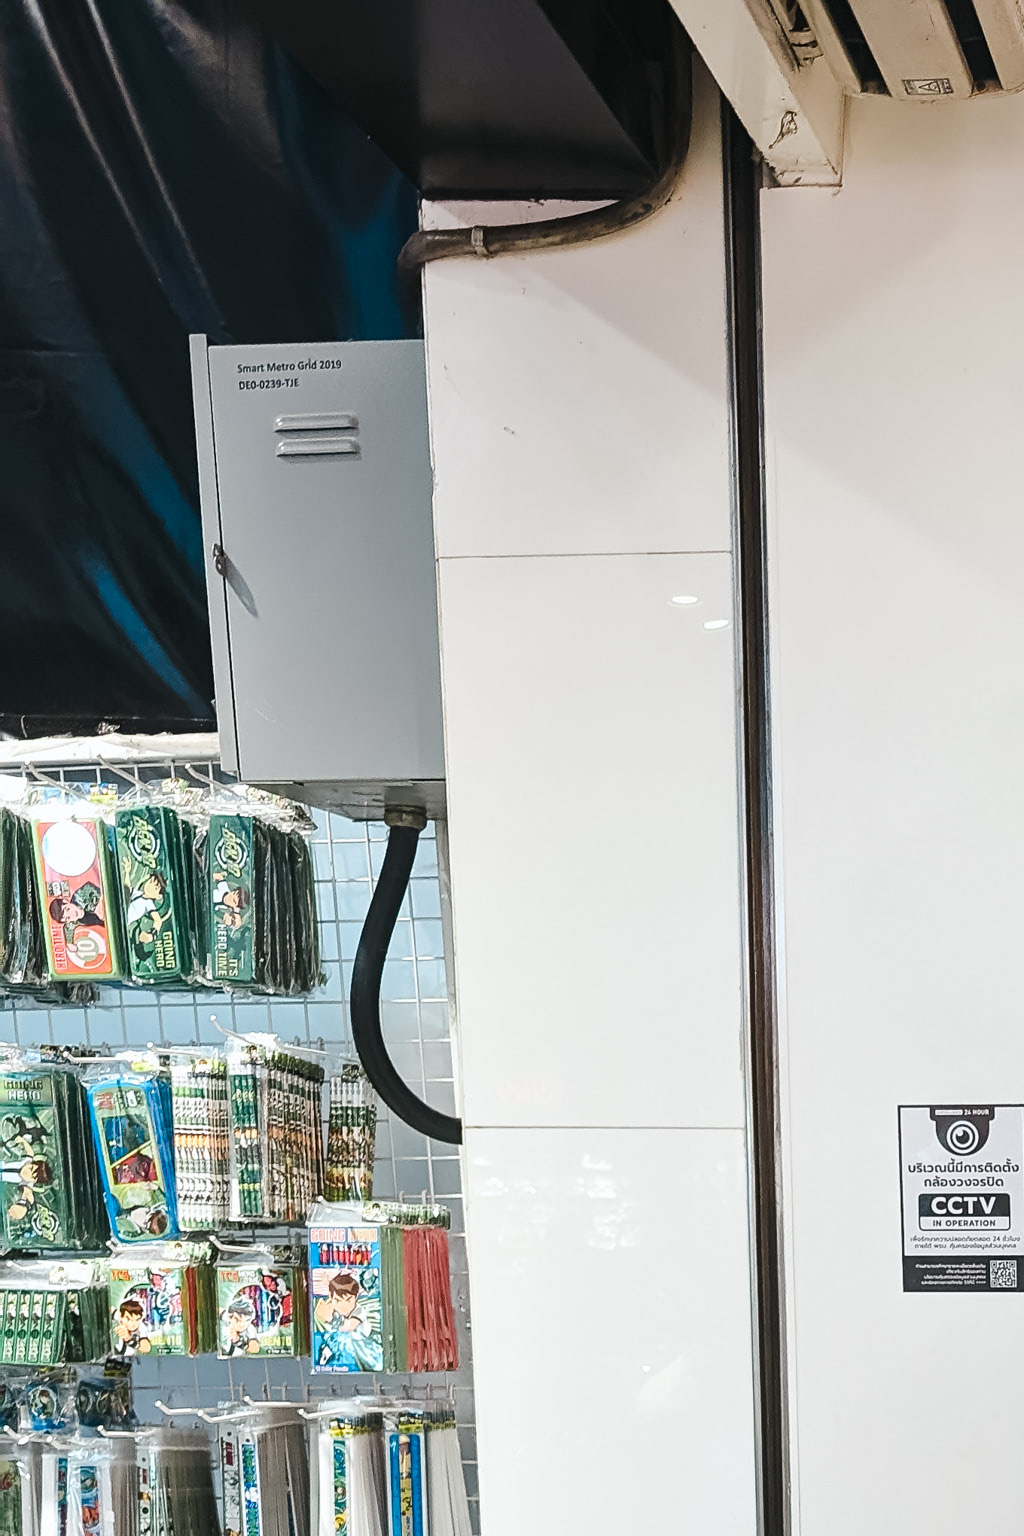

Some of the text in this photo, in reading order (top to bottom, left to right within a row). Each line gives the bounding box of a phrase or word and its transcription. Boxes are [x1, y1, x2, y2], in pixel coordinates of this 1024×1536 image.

[237, 359, 342, 373] Smart Metro Grid 2019
[154, 940, 165, 968] HERO
[163, 931, 176, 969] GOING
[217, 924, 228, 977] HERO TIME
[4, 1080, 44, 1091] GOING
[8, 1091, 41, 1101] HERO
[908, 1158, 1019, 1173] บริเวณนี้มีการติดตั้ง
[924, 1176, 1004, 1187] กล้องวงจรปิด
[931, 1196, 996, 1215] CCTV
